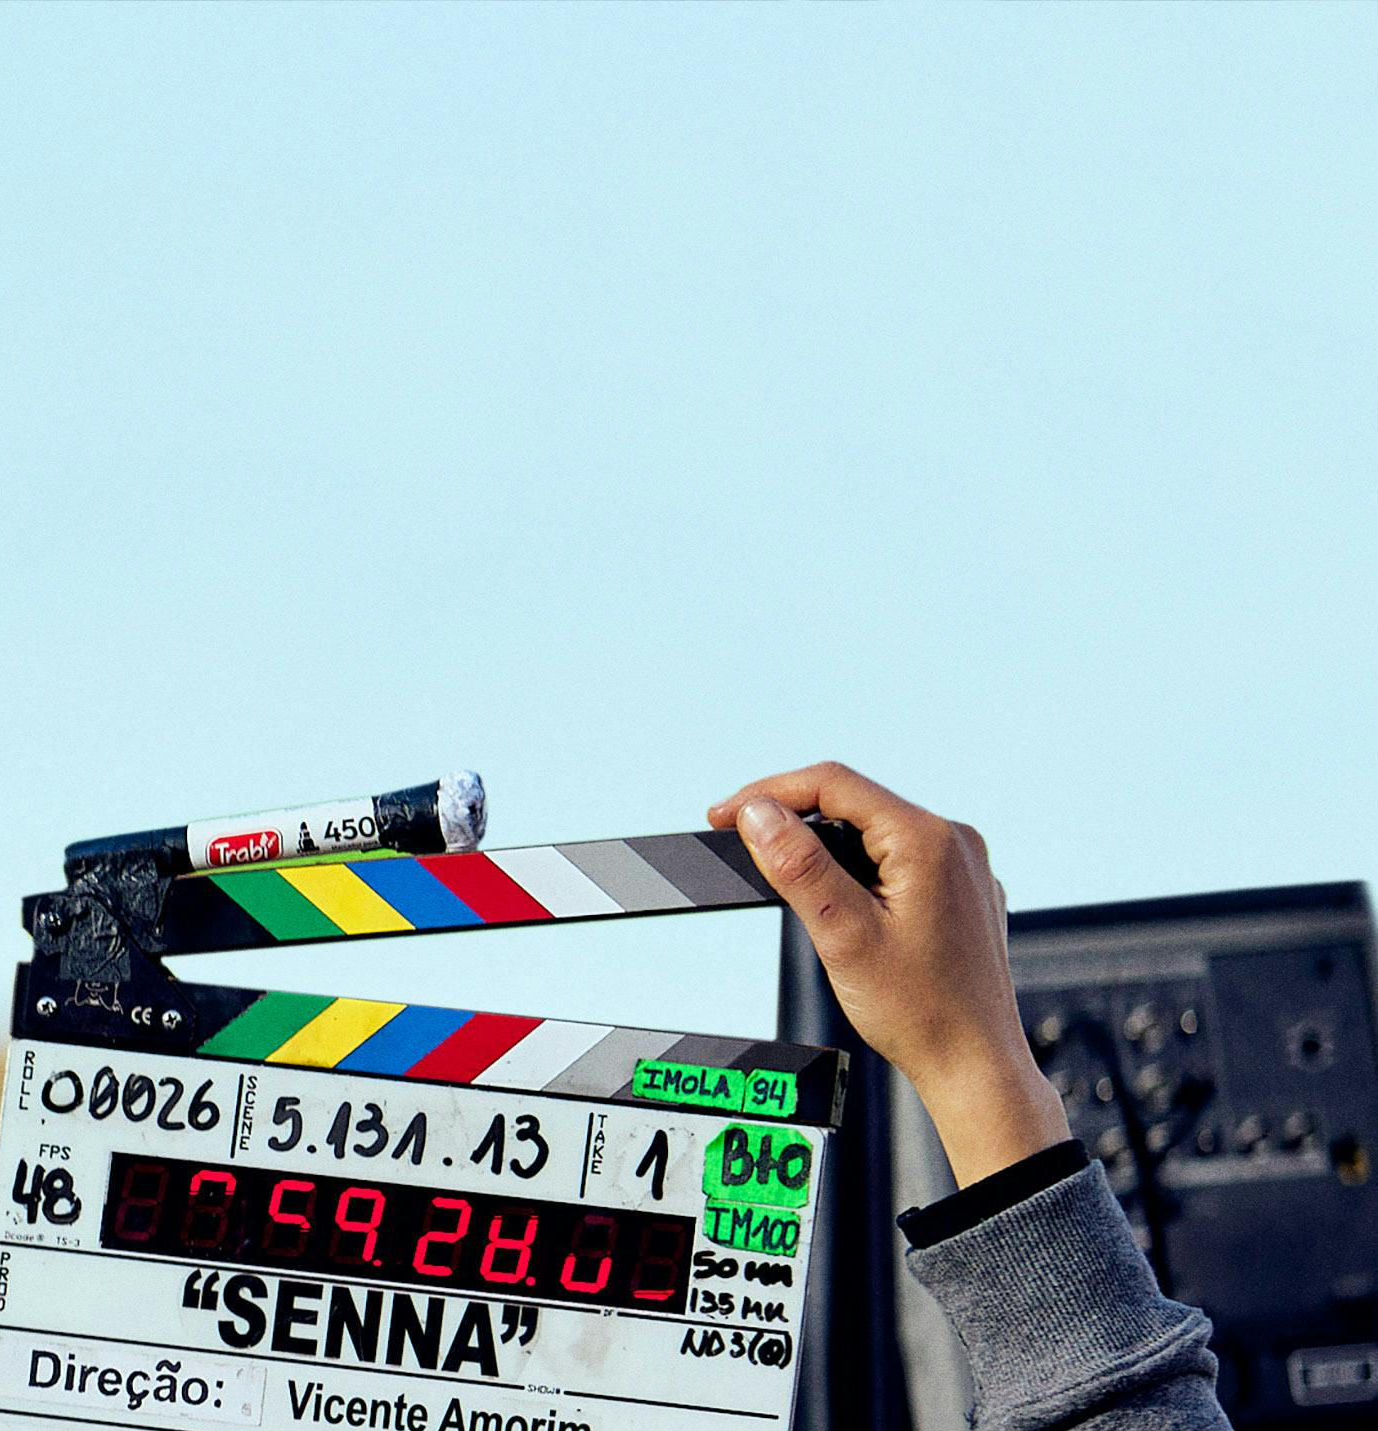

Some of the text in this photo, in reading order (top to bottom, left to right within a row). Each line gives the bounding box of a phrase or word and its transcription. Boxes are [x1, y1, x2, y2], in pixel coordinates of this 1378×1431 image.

[214, 817, 376, 866] Trabi 450
[19, 1051, 35, 1110] ROLL
[239, 1075, 257, 1151] SCENE
[39, 1144, 72, 1161] FPS
[591, 1114, 608, 1175] TAKE
[636, 1130, 669, 1200] 1
[12, 1158, 82, 1225] 48
[28, 1350, 224, 1410] Direção:
